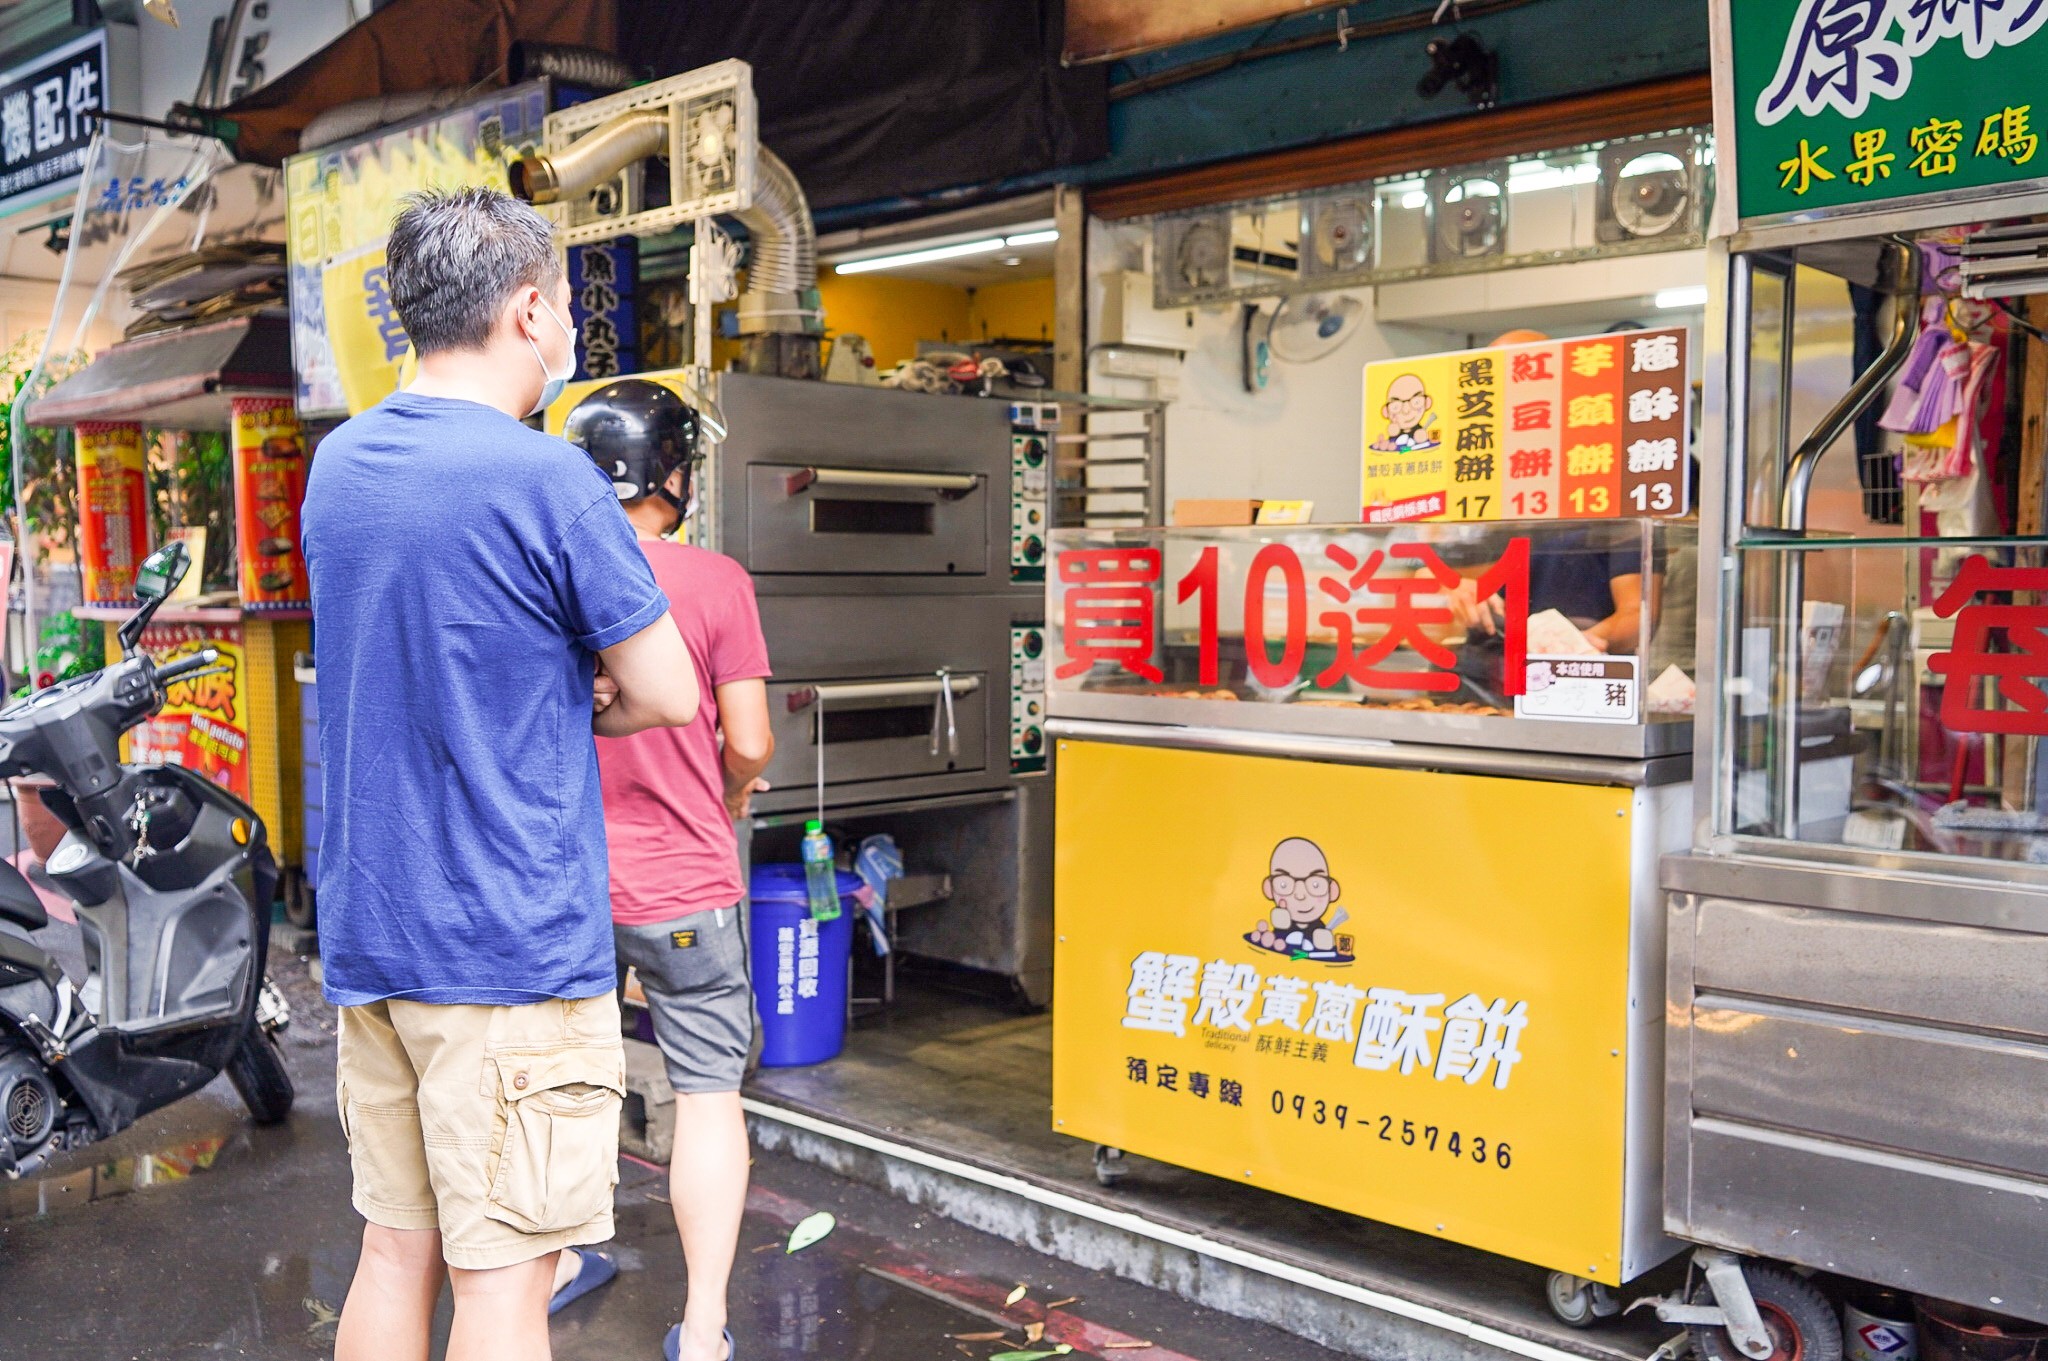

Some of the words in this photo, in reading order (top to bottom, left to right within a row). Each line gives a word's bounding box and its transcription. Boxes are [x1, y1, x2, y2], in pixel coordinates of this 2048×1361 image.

[1779, 105, 2039, 195] 水果密碼
[581, 240, 619, 377] 魚小丸子
[1455, 358, 1494, 482] 黑芝麻餅
[1509, 353, 1553, 478] 紅豆餅
[1567, 344, 1615, 476] 芋頭餅
[1456, 496, 1491, 518] 17
[1511, 491, 1549, 516] 13
[1569, 486, 1610, 513] 13
[1629, 483, 1673, 511] 13
[1555, 661, 1605, 677] 本店使用
[1605, 683, 1627, 707] 豬
[191, 712, 210, 734] Hot
[209, 724, 245, 751] potato
[1201, 1026, 1250, 1043] Traditional
[1204, 1040, 1236, 1052] delicacy
[1256, 1034, 1329, 1063] 酥鮮主義
[1126, 1056, 1243, 1107] 預定專線
[1272, 1090, 1512, 1169] 0939-257436
